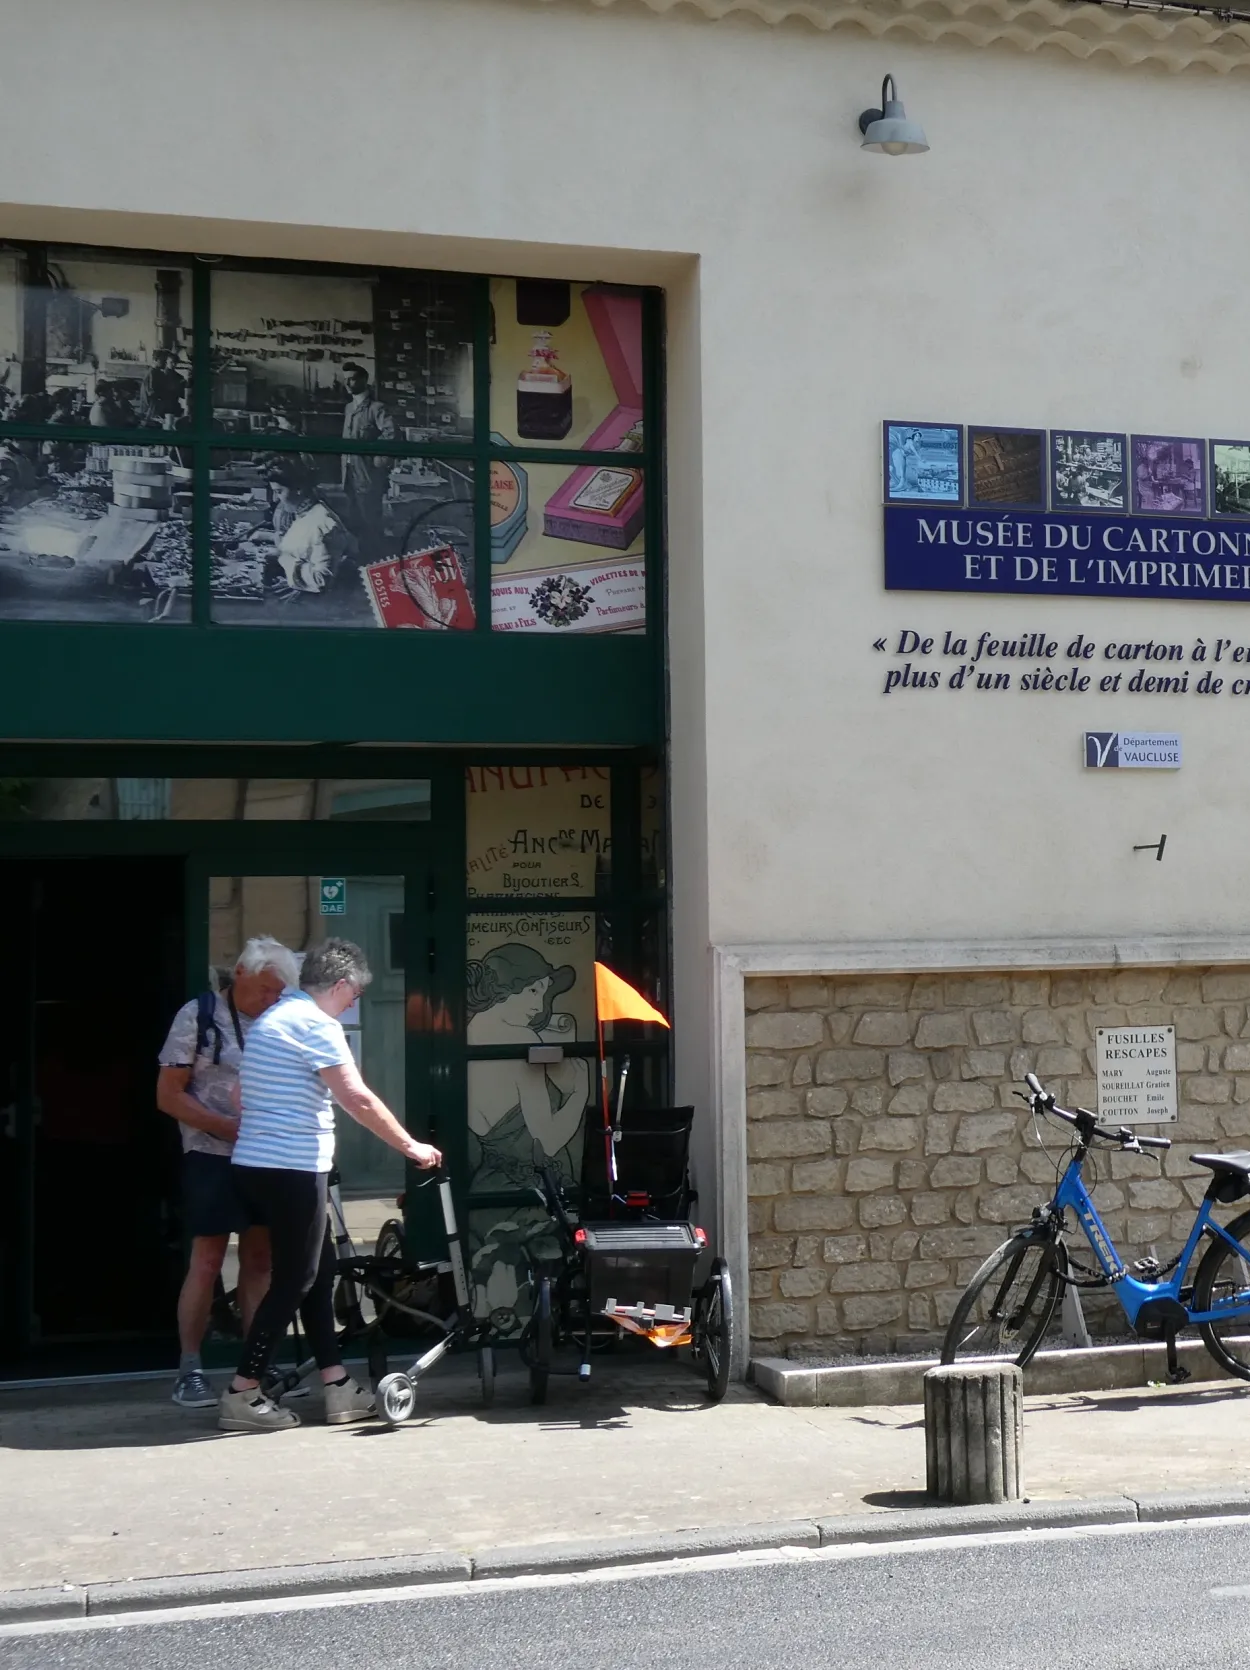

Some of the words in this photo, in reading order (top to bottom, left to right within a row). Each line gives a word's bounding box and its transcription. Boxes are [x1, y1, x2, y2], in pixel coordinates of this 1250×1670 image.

[916, 515, 1034, 548] MUSÉE
[1043, 523, 1093, 550] DU
[963, 554, 1004, 580] ET
[1013, 556, 1058, 582] DE
[590, 570, 628, 586] VIOLETTES
[372, 572, 391, 608] POSTES
[896, 630, 934, 655] De
[942, 631, 968, 656] la
[971, 631, 1058, 662] feuille
[1066, 634, 1096, 659] de
[1104, 639, 1184, 661] carton
[1191, 638, 1207, 662] à
[883, 663, 941, 694] plus
[948, 664, 1011, 690] d'un
[1020, 667, 1091, 692] siècle
[1099, 671, 1123, 693] et
[1128, 669, 1189, 693] demi
[1196, 670, 1224, 694] de
[1123, 737, 1179, 748] Département
[1124, 752, 1179, 763] VAUCLUSE
[512, 861, 542, 869] POUR
[322, 904, 344, 913] DAE
[1107, 1033, 1165, 1045] FUSILLES
[1105, 1047, 1168, 1060] RESCAPES
[1102, 1069, 1124, 1078] MARY
[1146, 1068, 1171, 1077] Auguste
[1101, 1081, 1144, 1091] SOUREILLAT
[1146, 1080, 1171, 1089] Gratien
[1102, 1094, 1138, 1104] BOUCHET
[1146, 1093, 1165, 1102] Emile
[1147, 1106, 1169, 1116] Joseph
[1083, 1207, 1119, 1274] TREK
